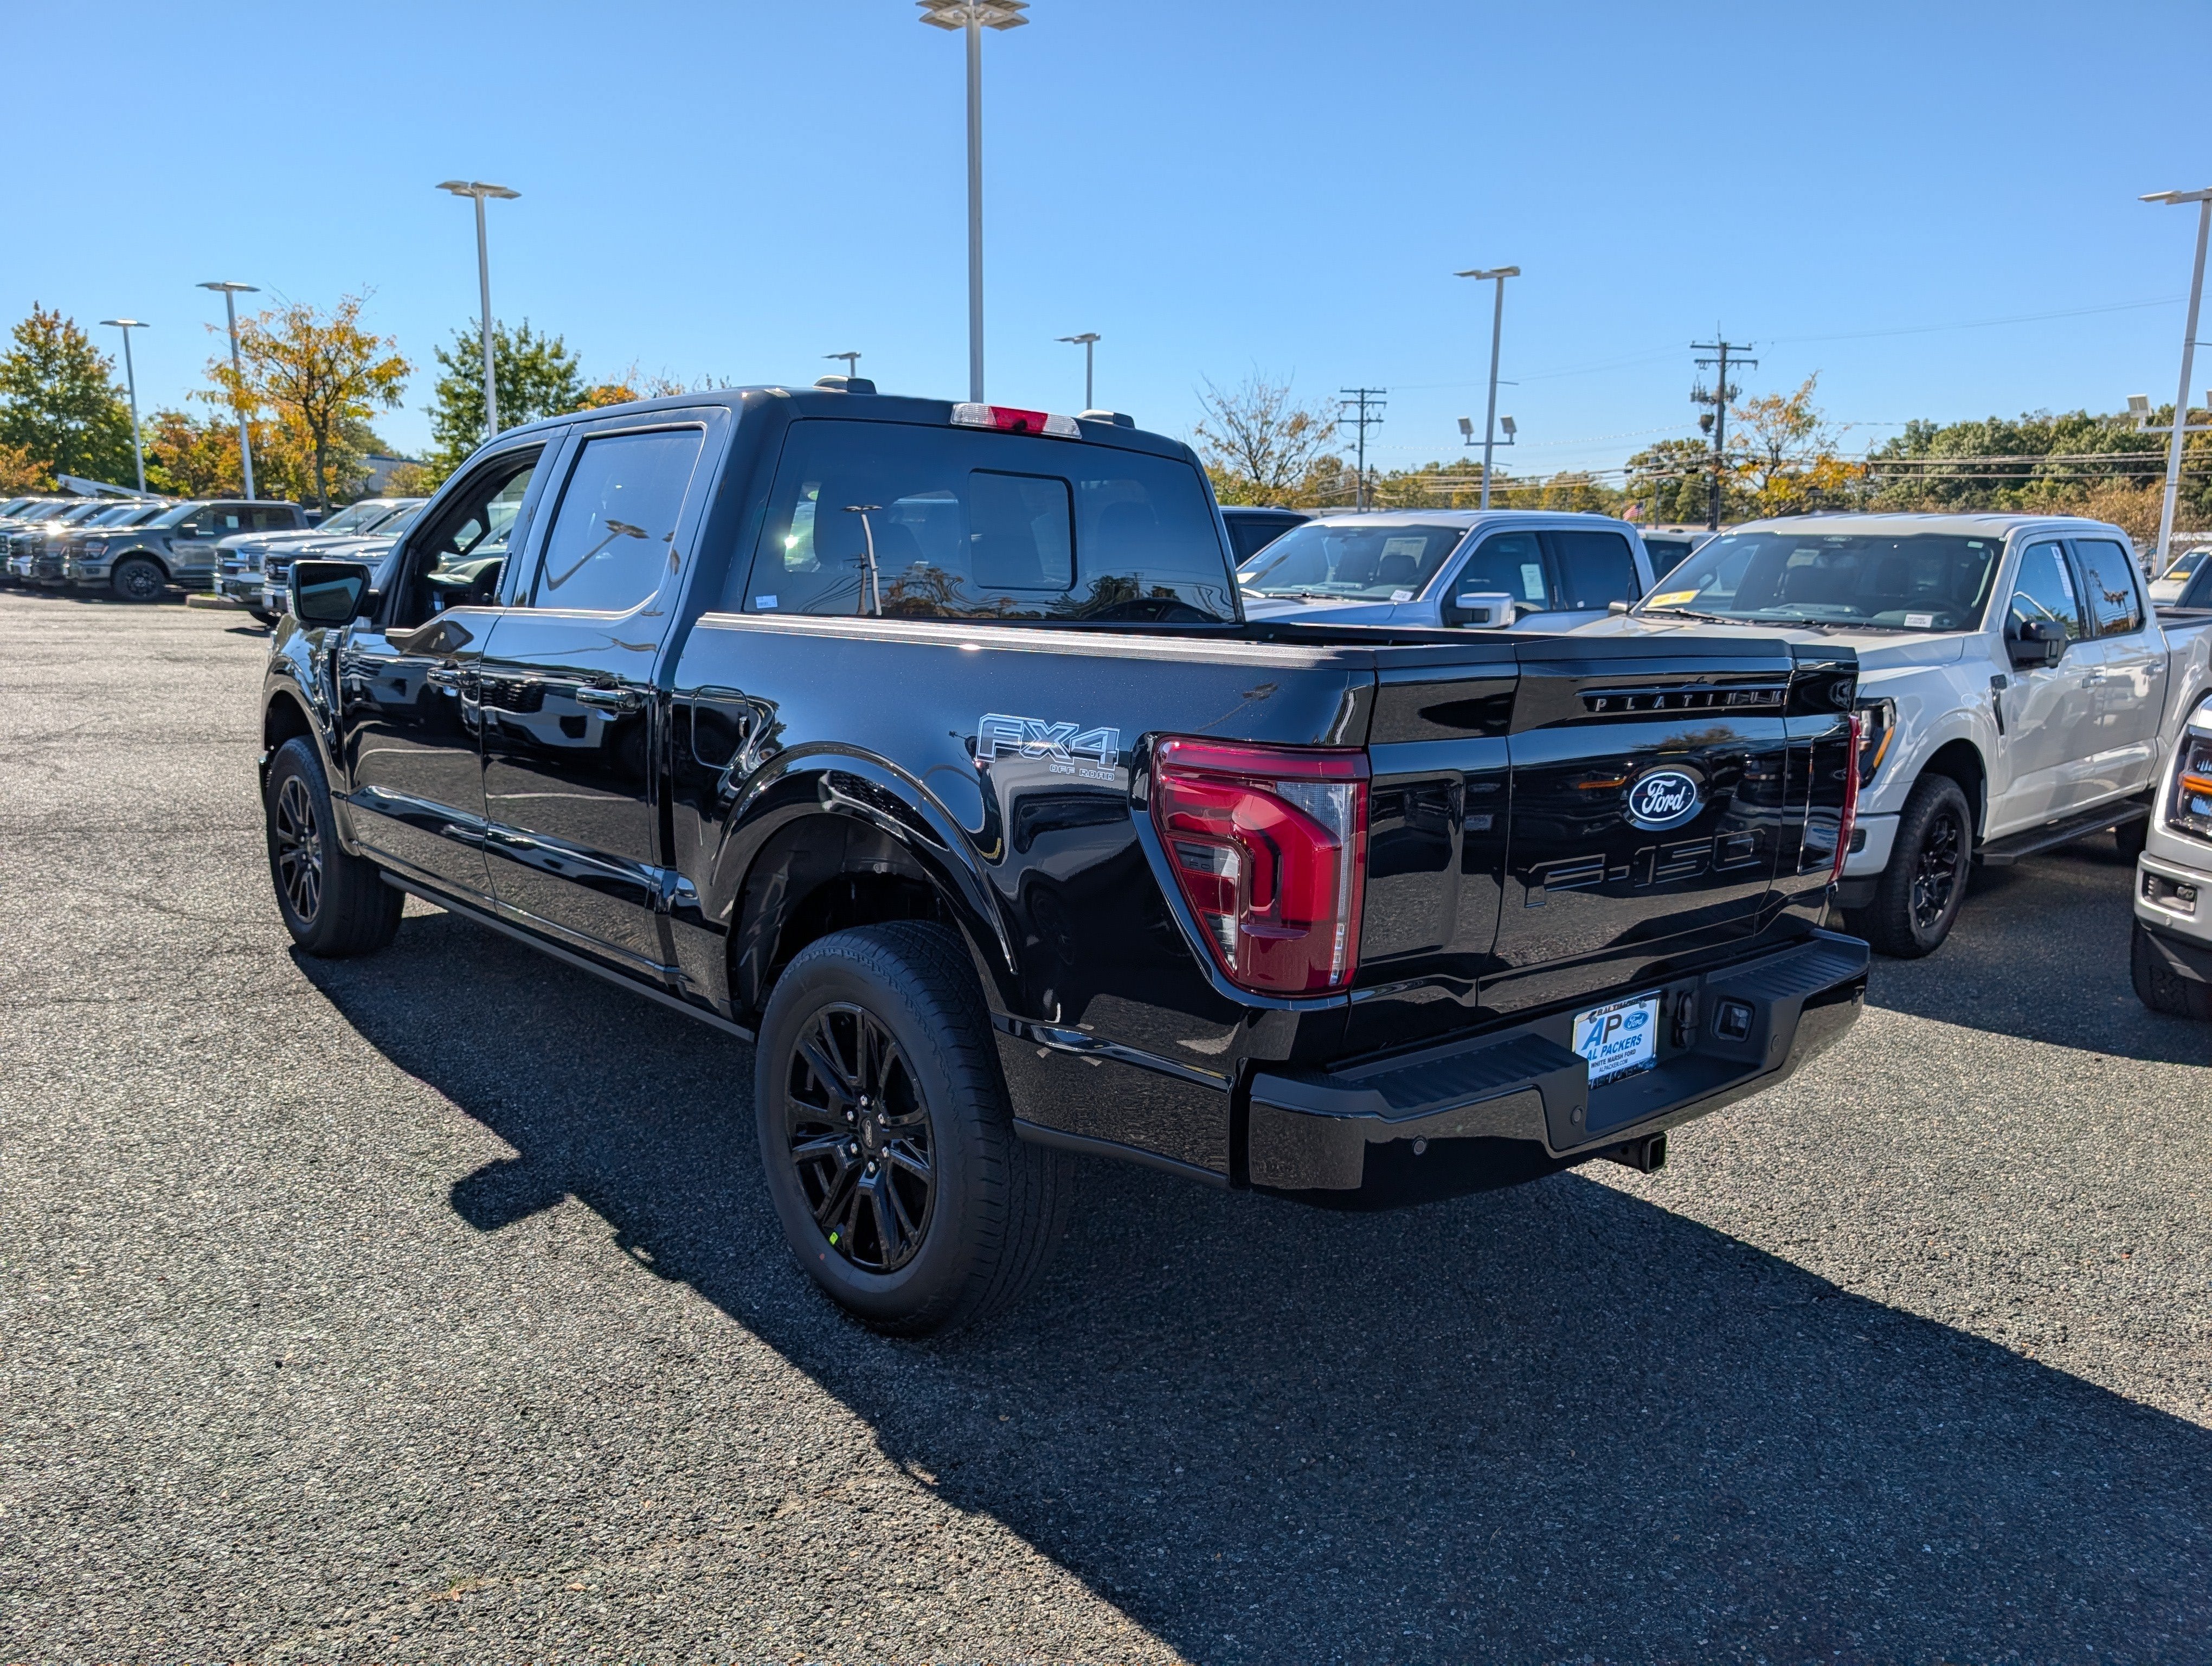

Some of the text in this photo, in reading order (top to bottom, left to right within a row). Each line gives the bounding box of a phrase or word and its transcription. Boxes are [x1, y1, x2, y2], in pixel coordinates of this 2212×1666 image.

[1594, 690, 1782, 712] PLATINUM
[976, 713, 1120, 771] FX4
[1050, 764, 1115, 781] OFF ROAD
[1642, 779, 1687, 814] Ford
[1525, 829, 1767, 908] F-150
[1581, 1014, 1644, 1051] AP Ford
[1587, 1033, 1642, 1061] AL PACKERS
[1591, 1048, 1636, 1068] WHITE MARSH FORD
[1599, 1059, 1628, 1073] ALPACKER.COM
